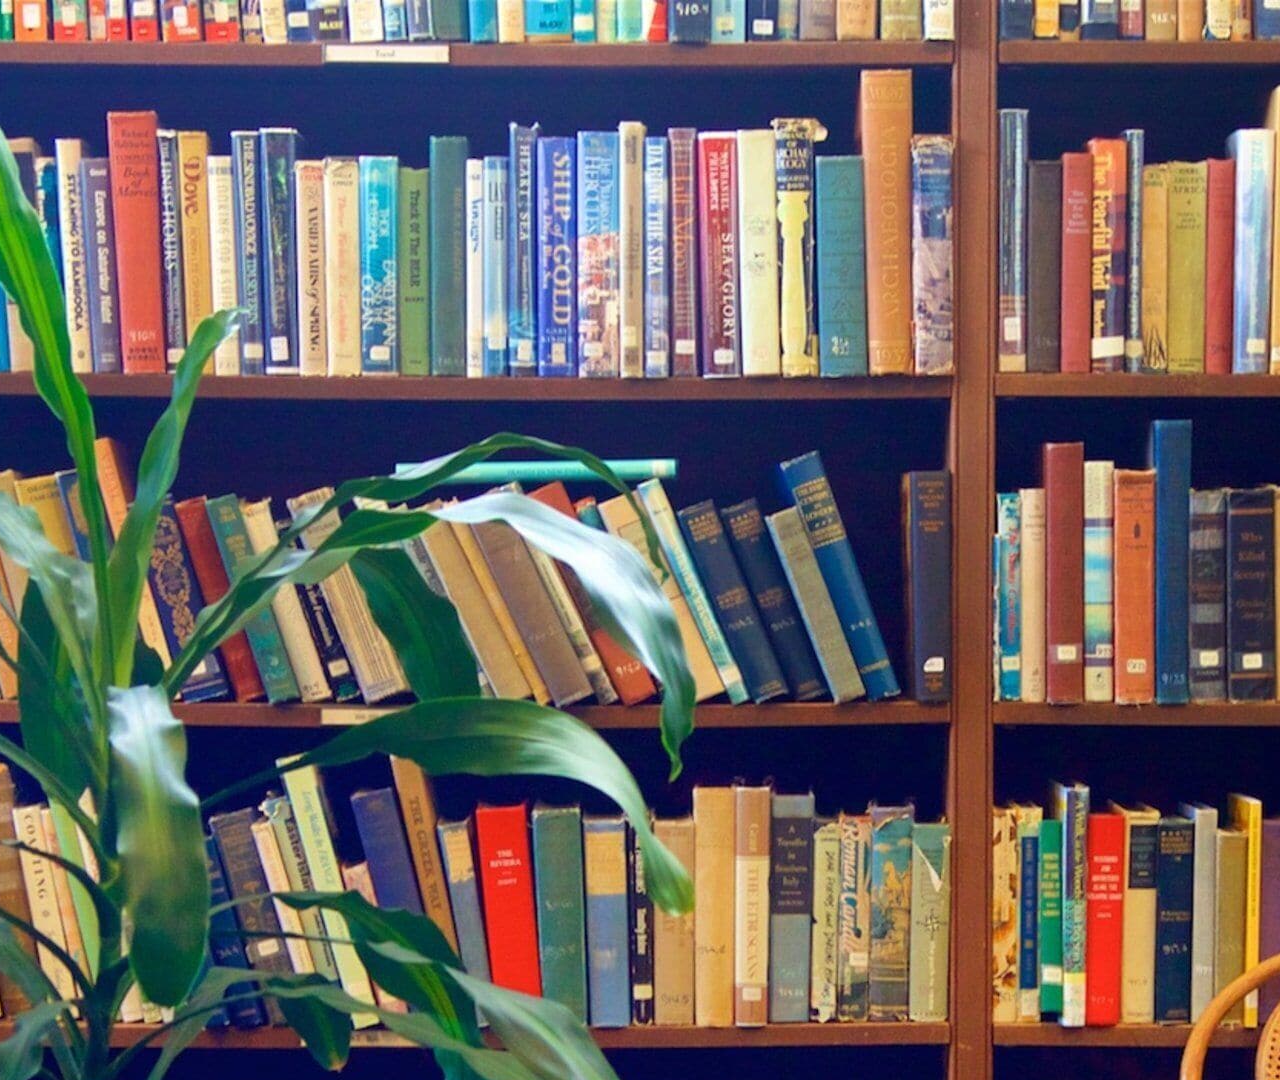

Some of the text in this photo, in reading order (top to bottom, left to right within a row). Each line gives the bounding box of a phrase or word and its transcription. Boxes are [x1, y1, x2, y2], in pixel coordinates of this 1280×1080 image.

[182, 157, 204, 218] Dove
[243, 156, 257, 211] SINDBAD
[519, 144, 532, 242] HEART SEA
[553, 152, 572, 222] SHIP
[584, 155, 601, 236] HERCULES
[646, 144, 664, 276] DARING THE SEA
[708, 150, 720, 213] PHILBRICK
[720, 150, 731, 212] NATHANIEL
[165, 210, 181, 271] HOURS
[245, 210, 258, 256] VOYAGE
[308, 205, 320, 257] VARIED
[410, 189, 422, 288] Track The BEAR
[540, 213, 552, 242] Deep
[550, 222, 567, 238] of
[721, 231, 735, 267] SEA
[879, 124, 899, 317] ARCHAEOLOGIA
[1091, 153, 1114, 291] The Fearful Void
[66, 174, 85, 332] STEAMING TO BAMBOOLA
[96, 190, 113, 325] Europe on Saturday Night
[541, 244, 552, 268] Blue
[541, 270, 552, 289] Sea
[361, 273, 375, 331] OCEAN
[383, 259, 397, 347] EARLY MAN
[553, 243, 572, 326] GOLD
[721, 280, 736, 339] GLORY
[310, 302, 321, 352] SPRING
[283, 815, 307, 861] Easter
[408, 796, 443, 912] THE GREEK WAY
[1073, 809, 1084, 842] Walk
[746, 868, 760, 898] THE
[825, 850, 837, 873] DEAR
[841, 825, 859, 890] Roman
[746, 901, 761, 980] ETRUSCANS
